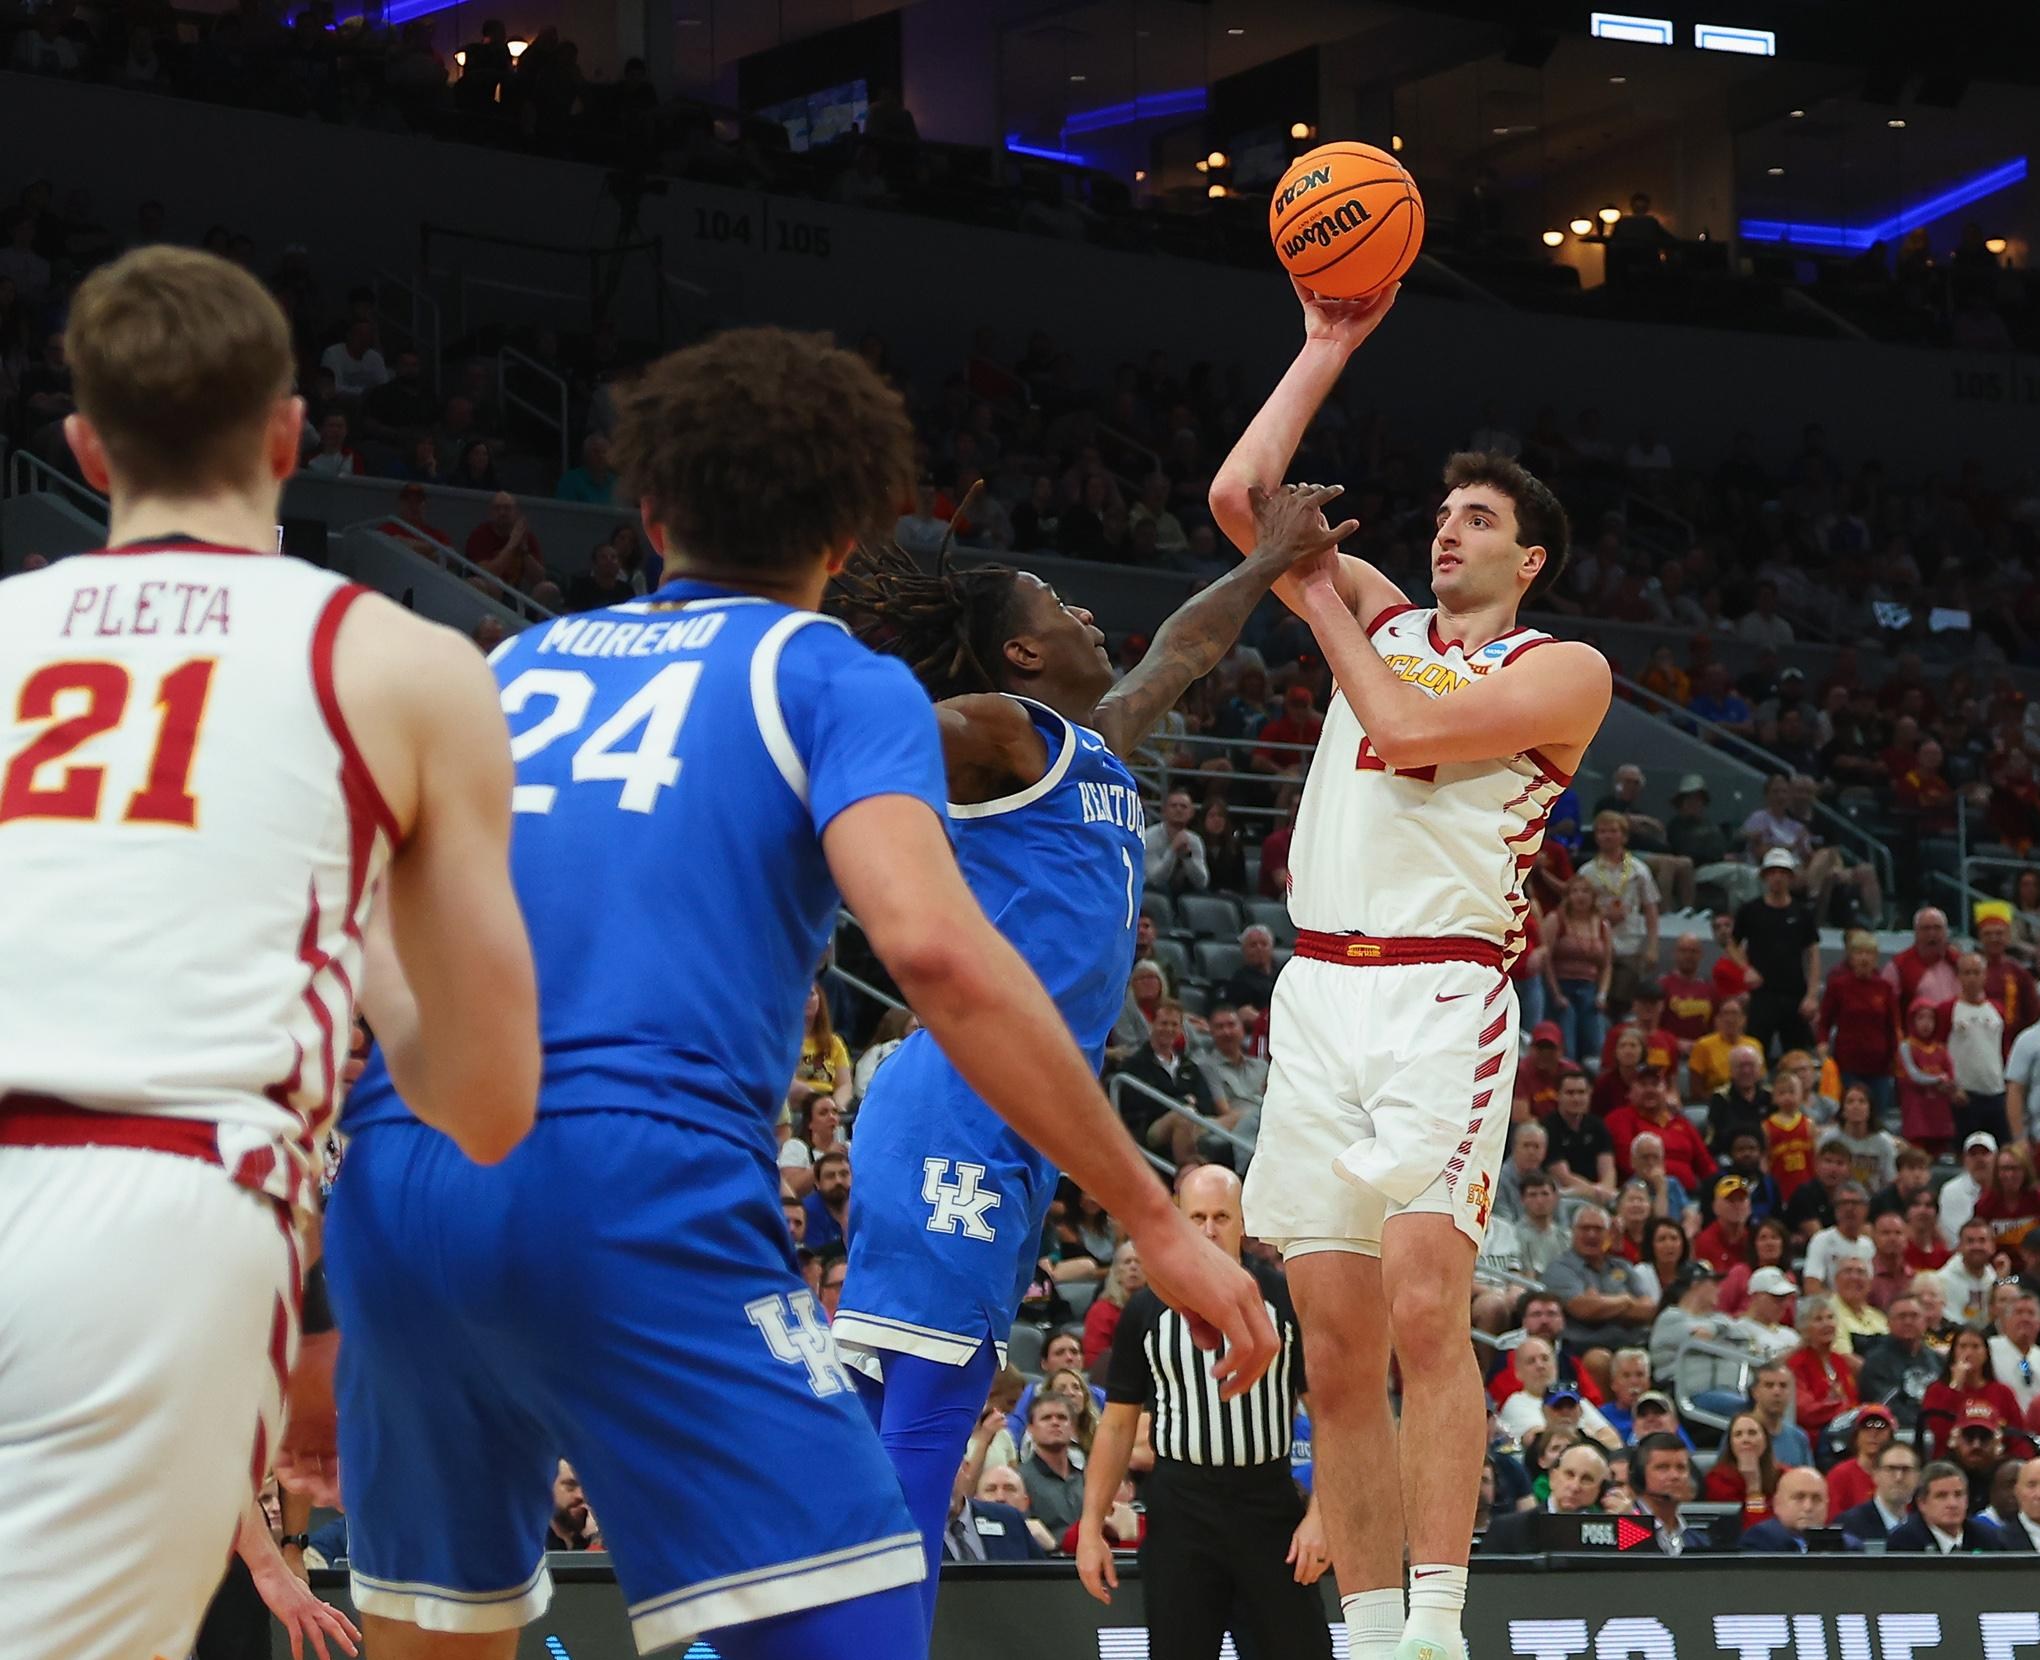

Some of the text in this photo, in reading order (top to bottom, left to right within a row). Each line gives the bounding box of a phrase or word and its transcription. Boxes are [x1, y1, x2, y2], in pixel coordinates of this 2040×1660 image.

[693, 206, 831, 260] 104 105
[1281, 199, 1372, 259] Wilson
[60, 581, 231, 638] PLETA
[536, 611, 727, 658] MORENO
[0, 656, 220, 832] 21
[500, 660, 704, 815] 24
[1078, 781, 1147, 850] KENTUC
[1121, 845, 1135, 931] 1
[921, 1157, 1001, 1242] UK
